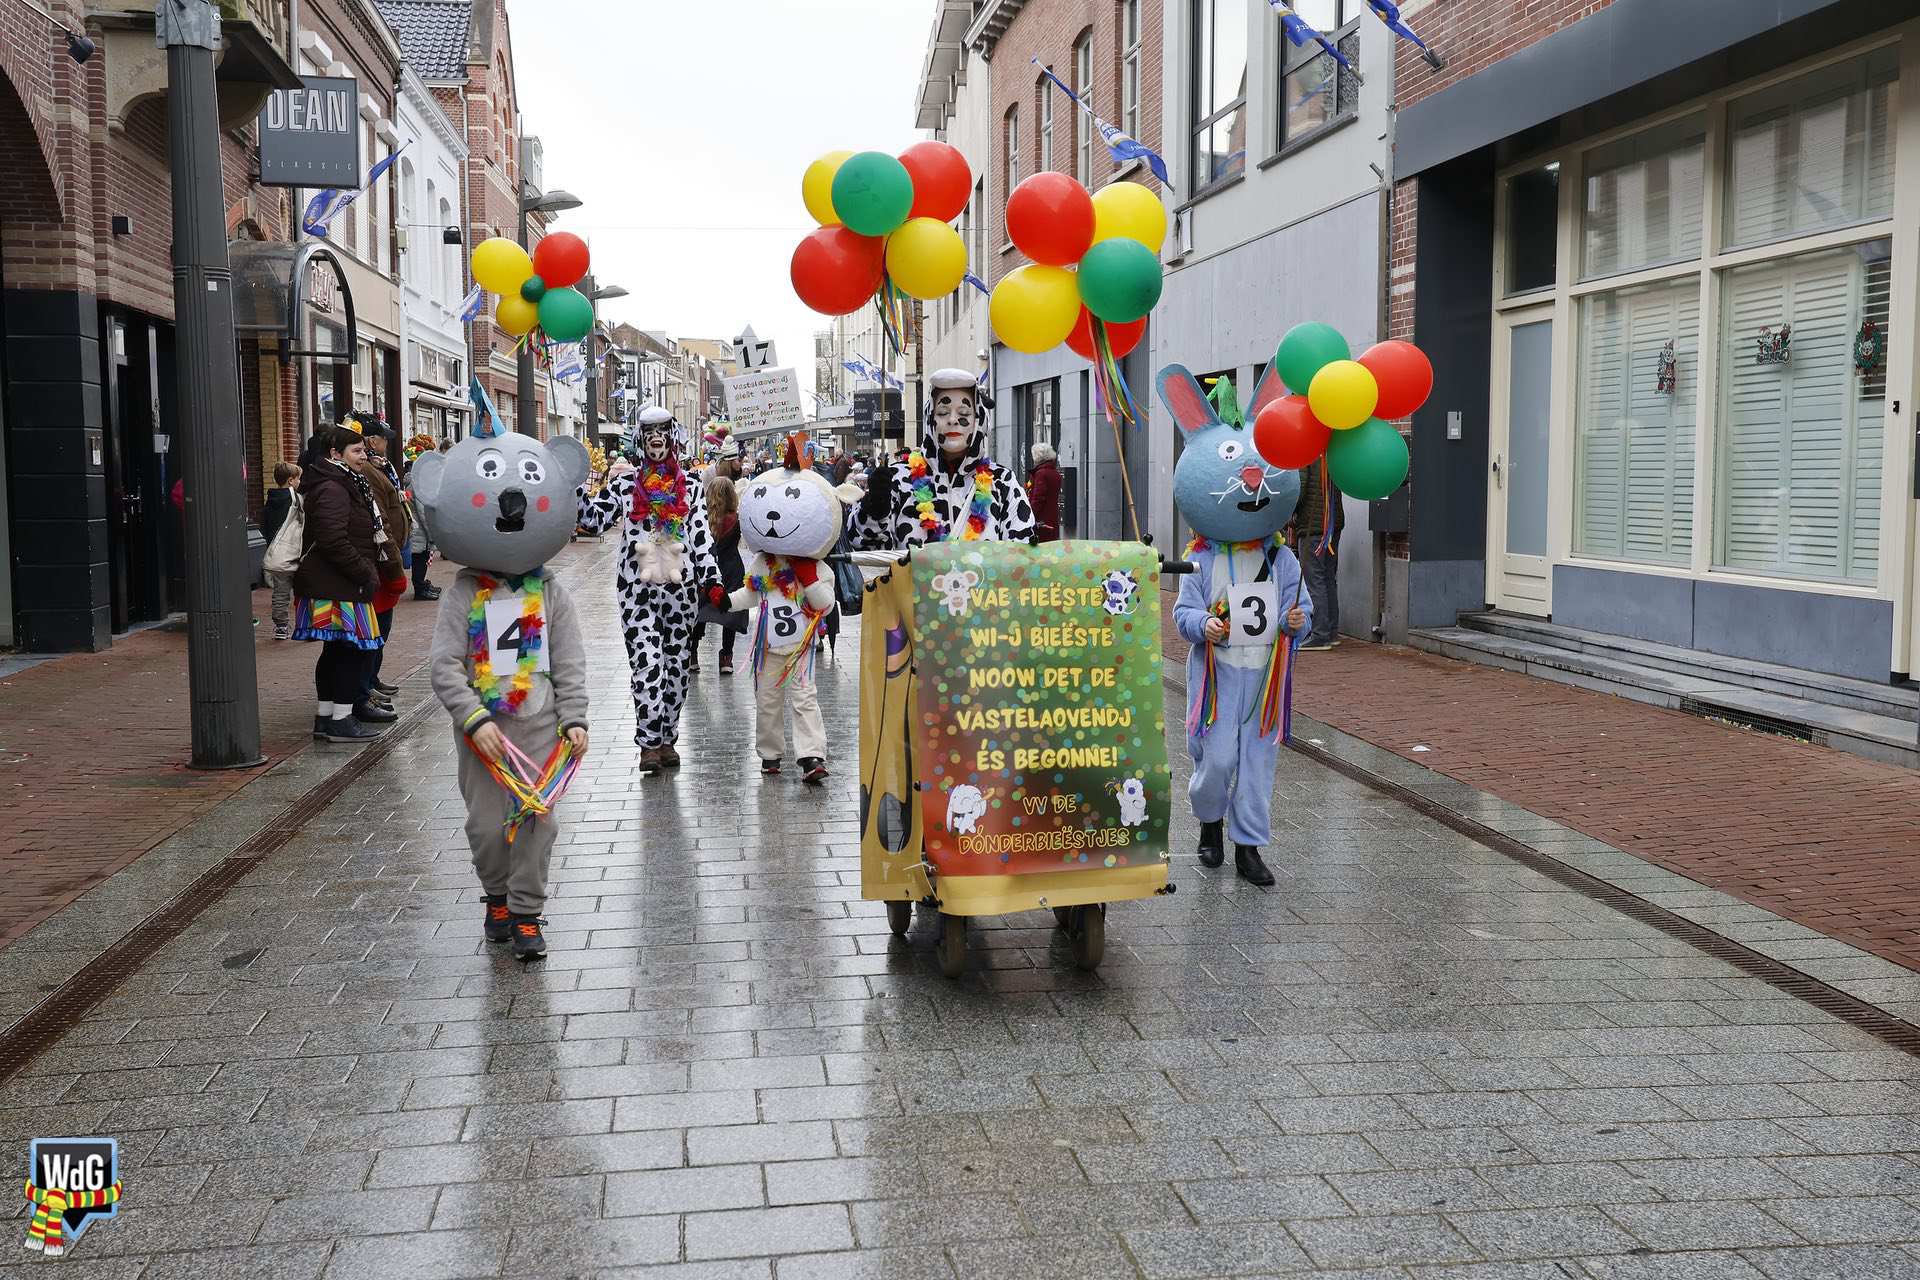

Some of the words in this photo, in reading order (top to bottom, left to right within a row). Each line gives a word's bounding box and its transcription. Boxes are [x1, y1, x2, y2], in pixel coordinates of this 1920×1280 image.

[267, 89, 349, 134] DEAN
[739, 342, 770, 369] 17
[970, 587, 1010, 607] VAE
[1019, 582, 1104, 607] FIEËSTE
[772, 605, 797, 637] 5
[1241, 596, 1267, 636] 3
[497, 616, 541, 662] 4
[970, 627, 1022, 648] WI-J
[1030, 622, 1113, 648] BIEËSTE
[969, 667, 1035, 689] NOOW
[1043, 667, 1083, 688] DET
[1090, 667, 1116, 688] DE
[956, 707, 1132, 732] VASTELAOVENDJ
[976, 738, 1005, 771] ÉS
[1013, 746, 1118, 770] BEGONNE!
[1022, 796, 1048, 815] VV
[1053, 794, 1077, 814] DE
[958, 825, 1131, 855] DÓNDERBIEËSTJES
